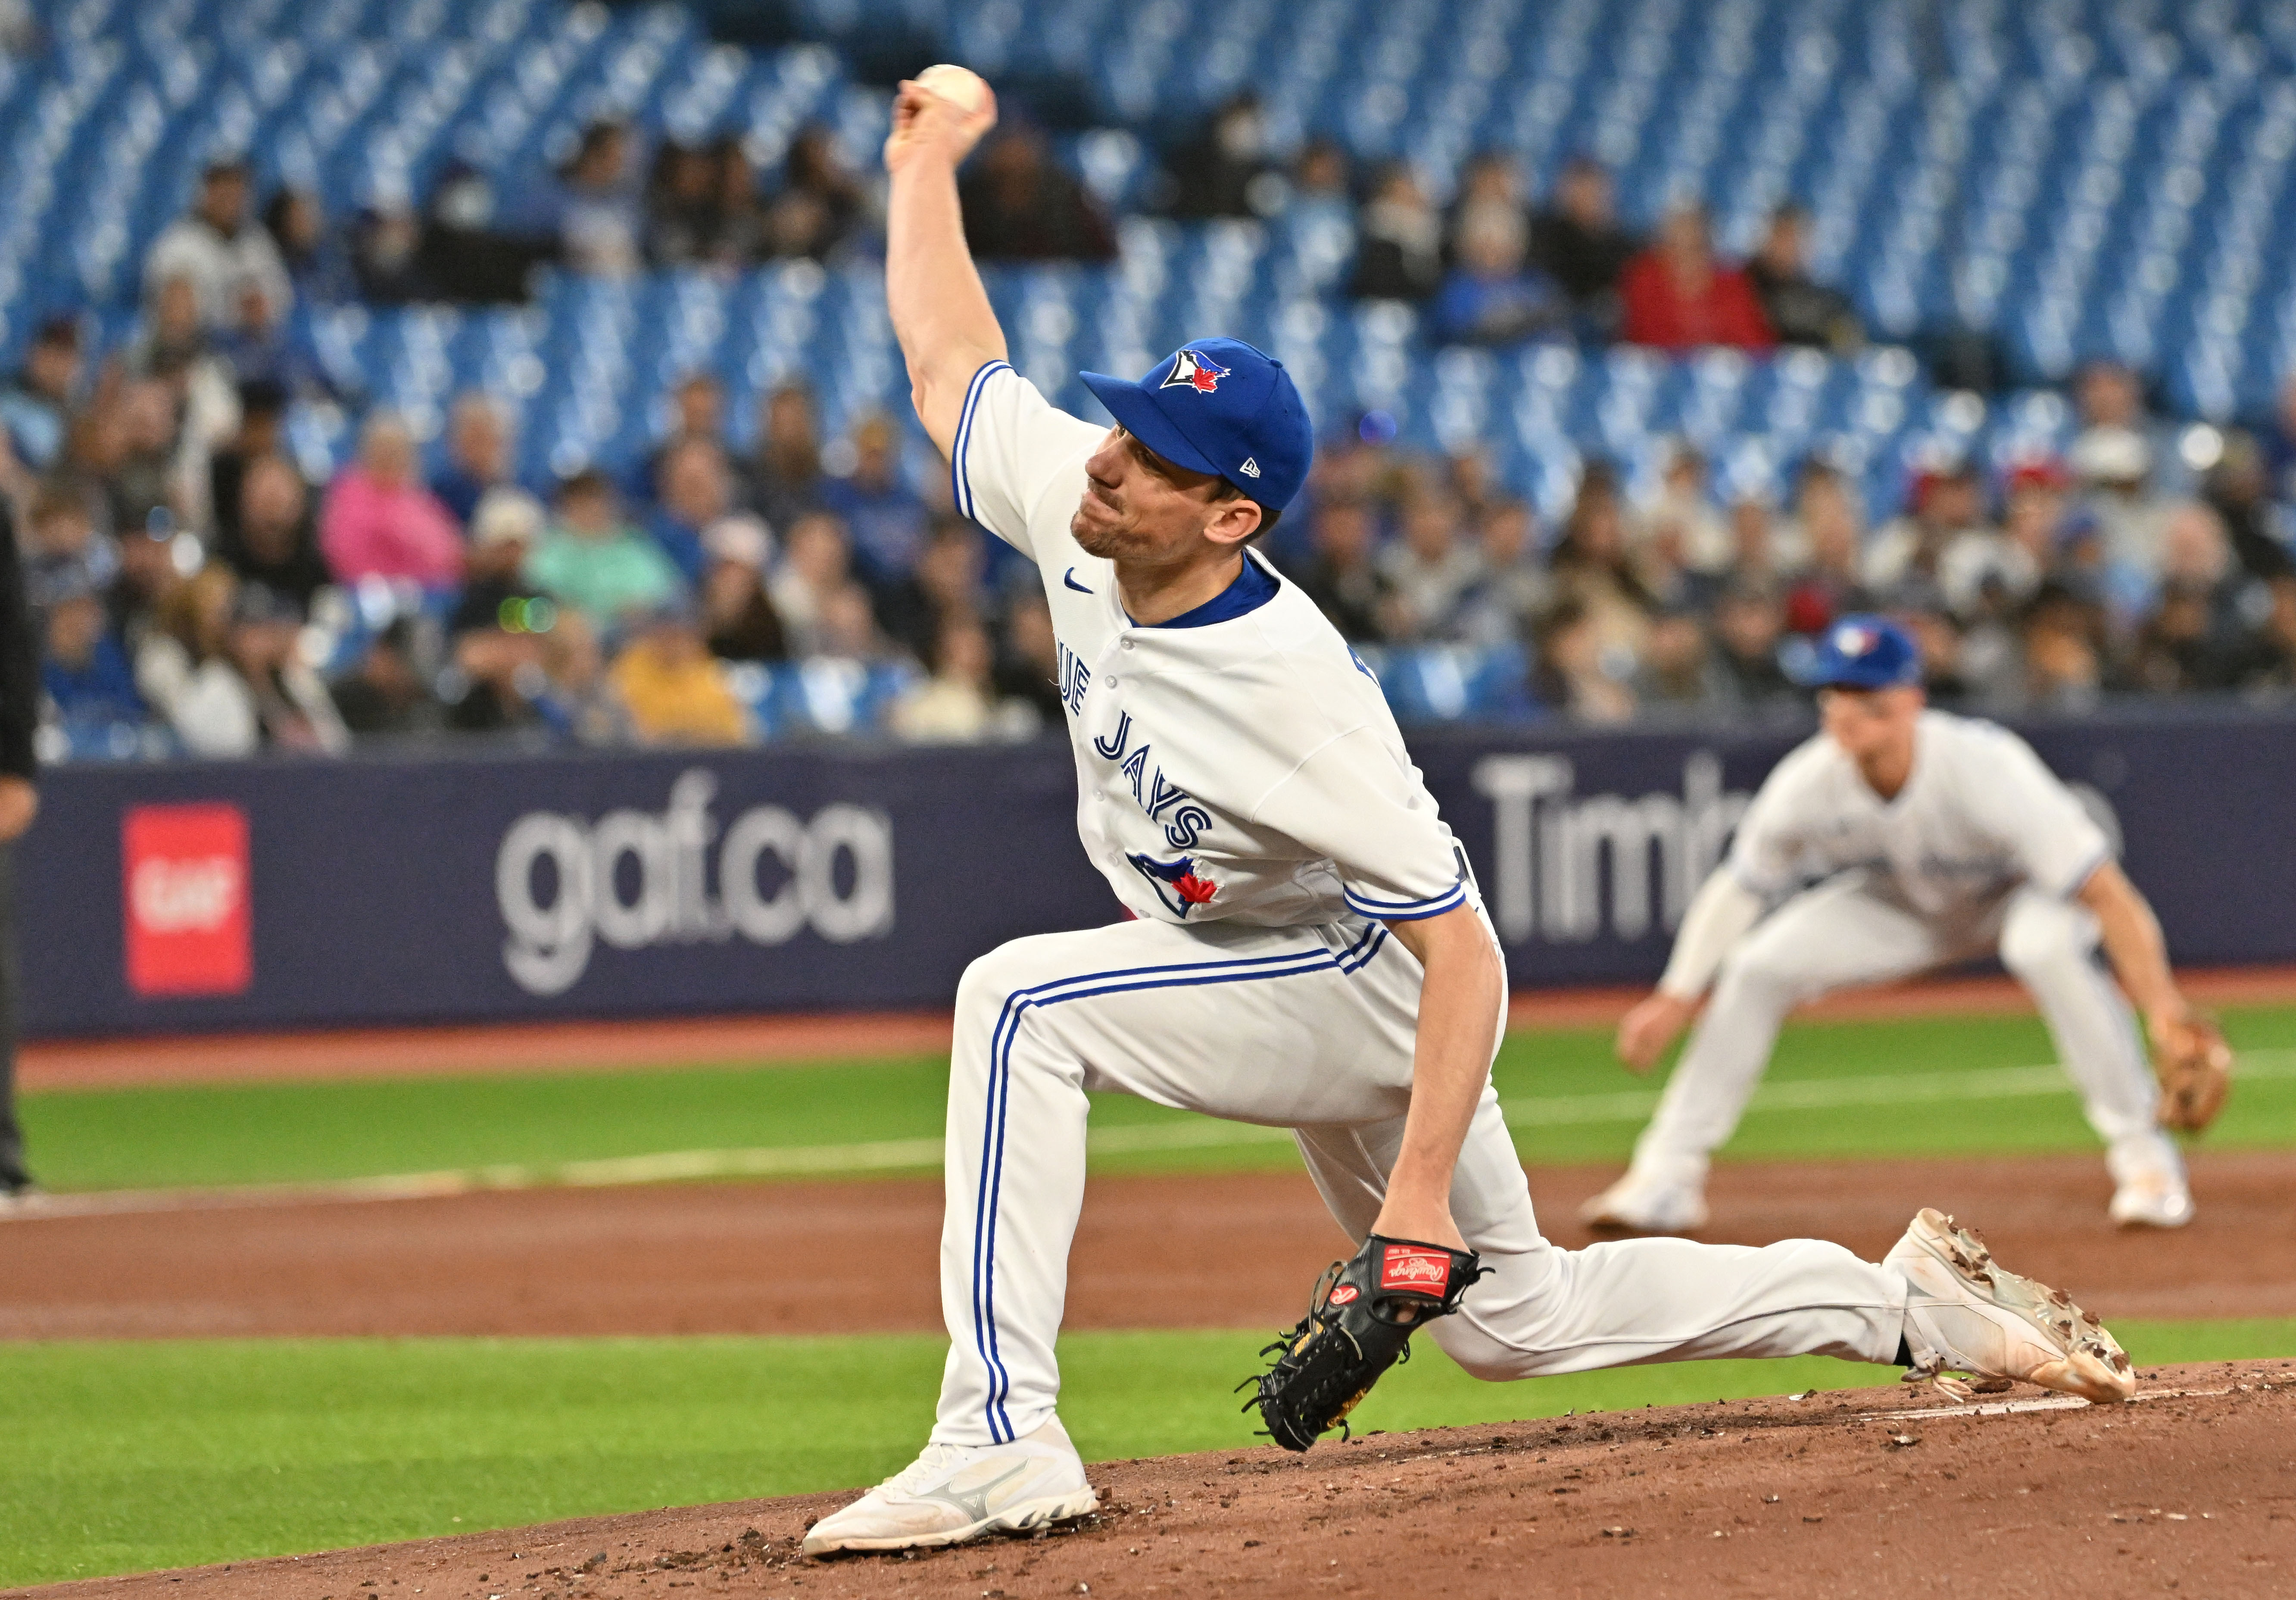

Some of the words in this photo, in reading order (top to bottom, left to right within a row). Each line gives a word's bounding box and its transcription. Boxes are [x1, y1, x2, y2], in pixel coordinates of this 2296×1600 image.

[1057, 637, 1091, 717] UE
[1094, 709, 1212, 849] JAYS
[496, 767, 895, 996] gaf.ca
[1388, 1257, 1444, 1282] Rawlings
